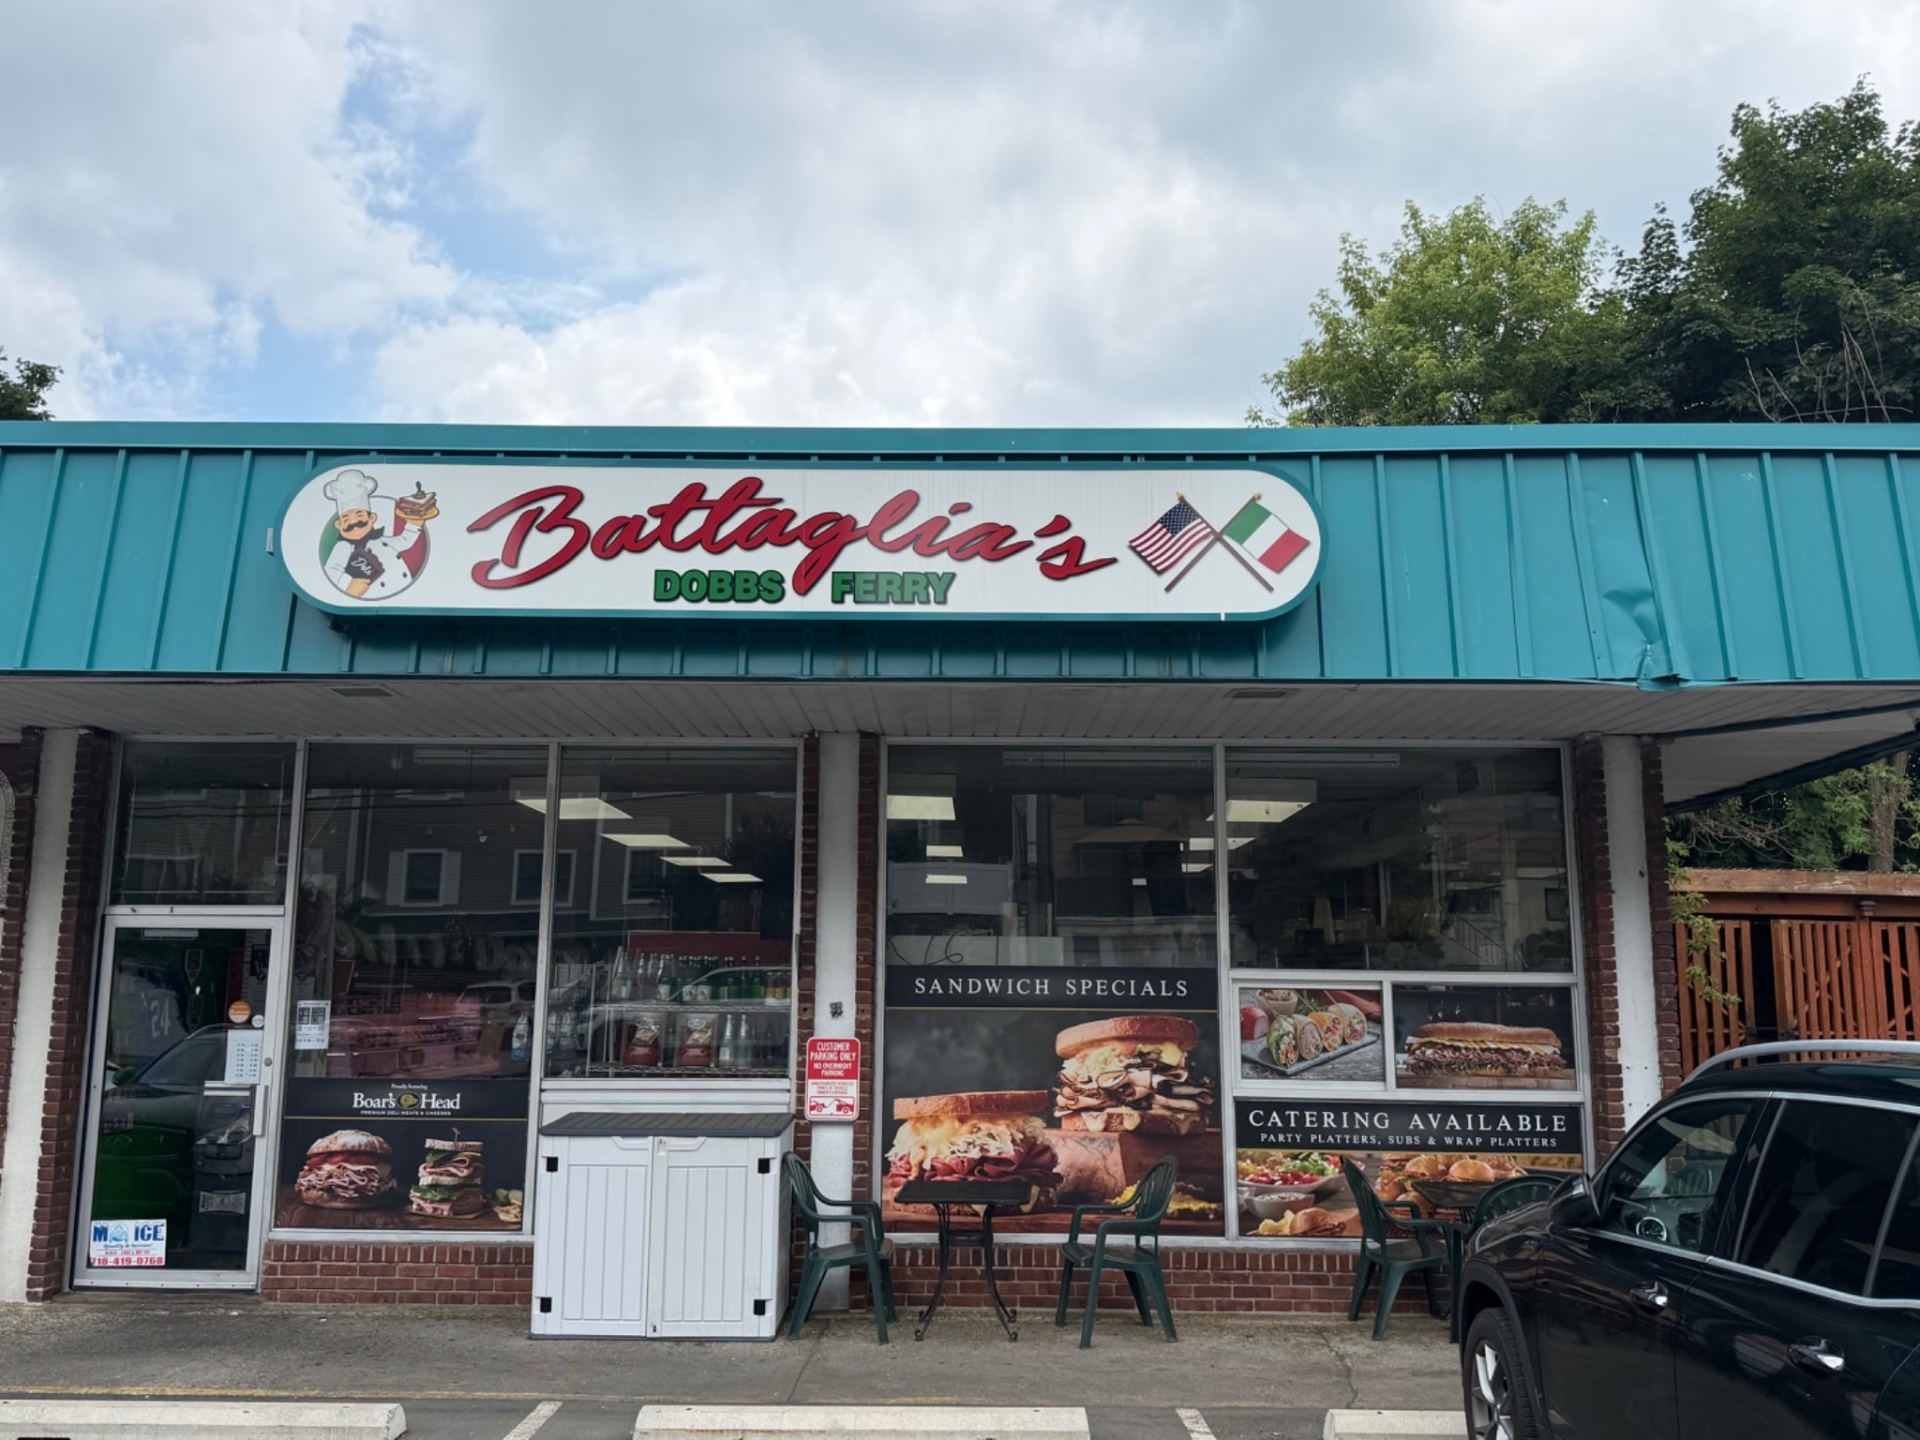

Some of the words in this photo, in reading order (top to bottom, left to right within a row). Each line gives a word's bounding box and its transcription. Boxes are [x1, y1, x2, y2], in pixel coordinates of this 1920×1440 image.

[467, 476, 1118, 595] Battaglia's
[653, 569, 783, 604] DOBBS
[831, 571, 956, 606] FERRY
[914, 978, 1050, 995] SANDWICH
[1065, 979, 1188, 997] SPECIALS
[817, 1042, 850, 1050] CUSTOMER
[810, 1052, 838, 1061] PARKING
[840, 1052, 856, 1061] ONLY
[822, 1062, 852, 1070] OVERNIGHT
[353, 1092, 396, 1108] Boar's
[420, 1093, 460, 1109] Head
[1248, 1110, 1390, 1128] CATERING
[1409, 1113, 1567, 1132] AVAILABLE
[1260, 1132, 1302, 1143] PARTY
[1310, 1134, 1382, 1145] PLATTERS,
[1388, 1135, 1421, 1145] SUBS
[1427, 1136, 1436, 1145] &
[1444, 1136, 1483, 1146] WRAP
[1490, 1137, 1557, 1147] PLATTERS
[134, 1222, 164, 1241] ICE
[91, 1257, 163, 1265] 718-419-0768
